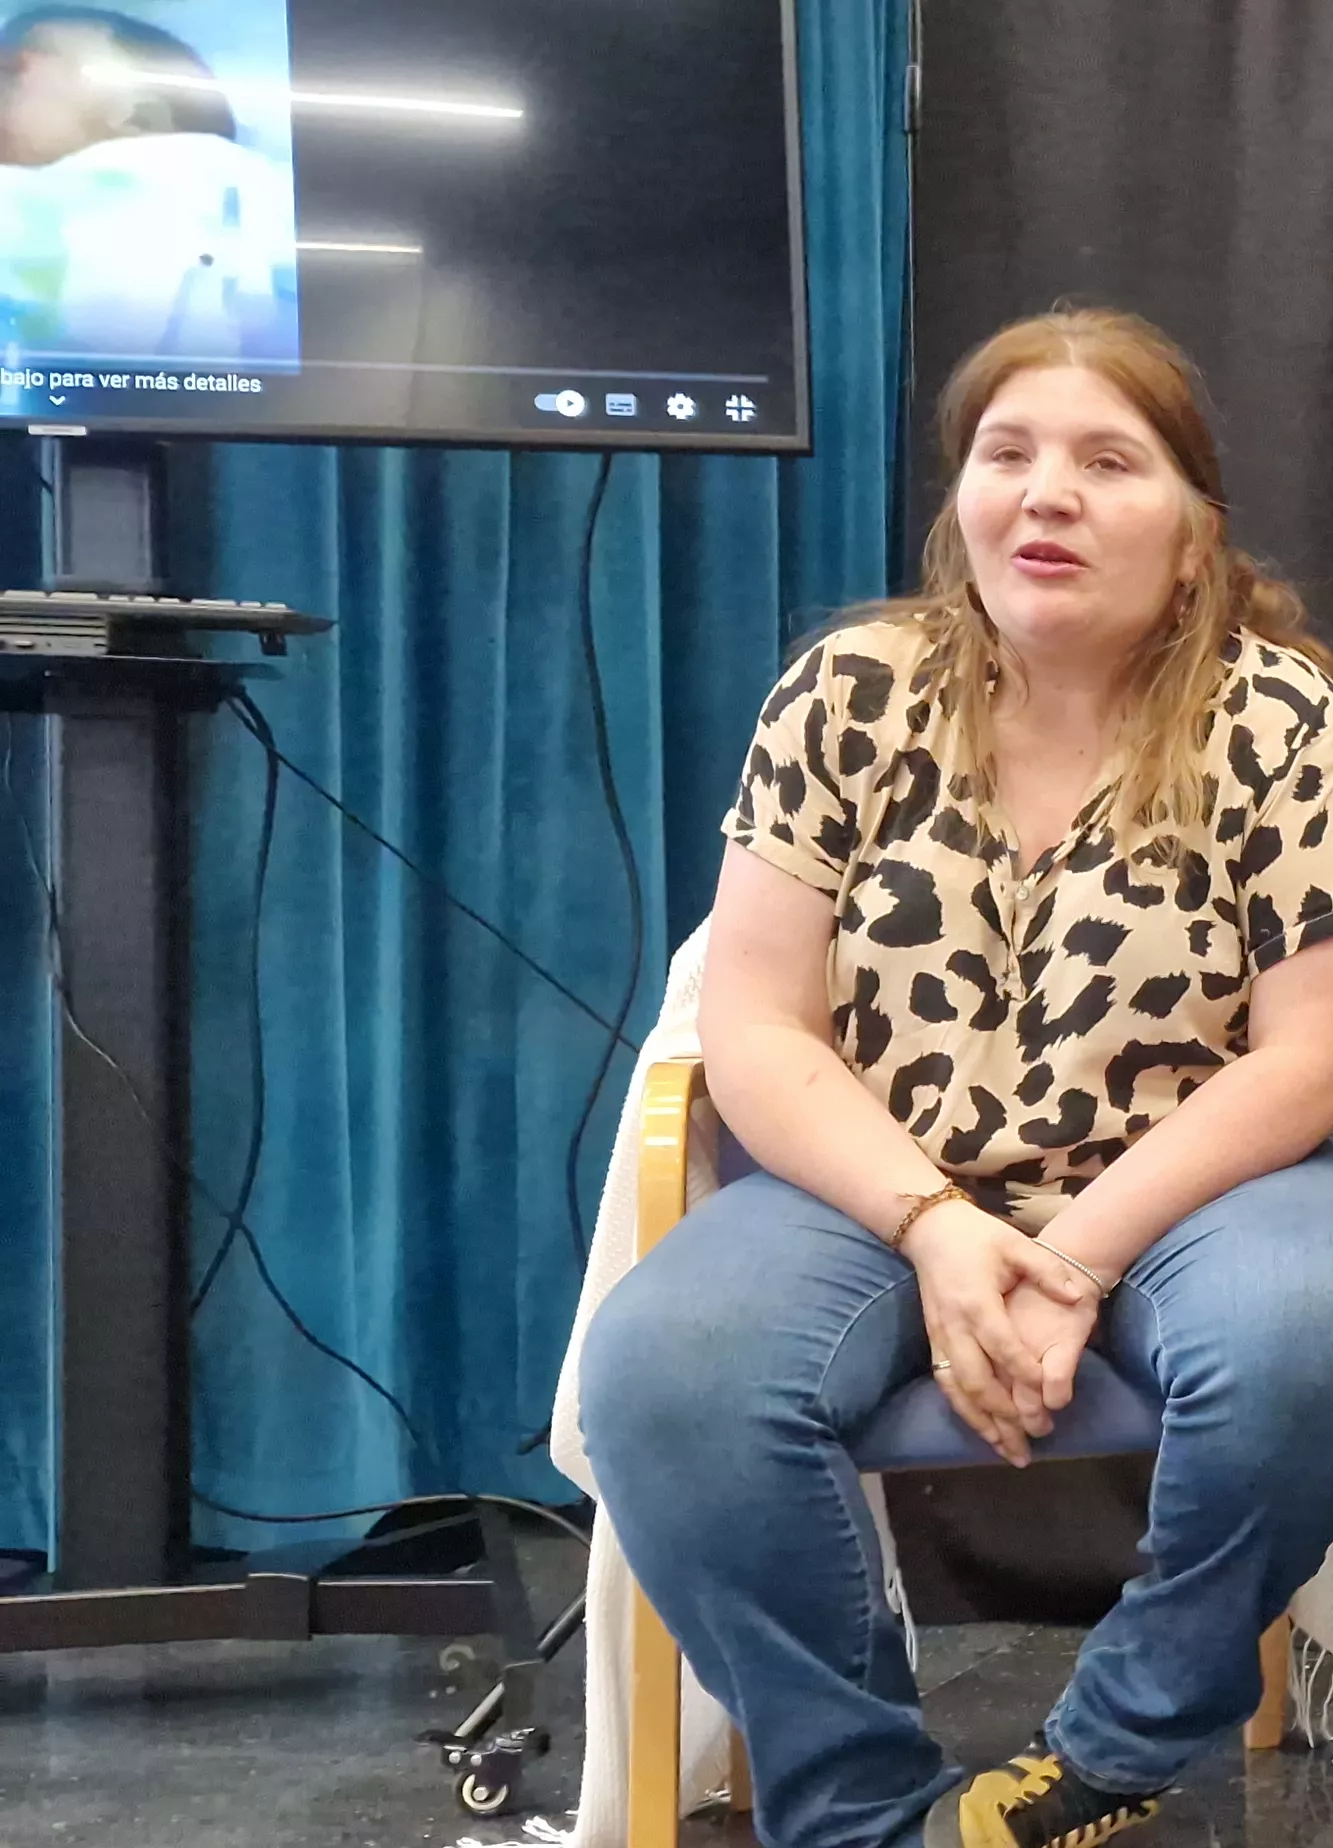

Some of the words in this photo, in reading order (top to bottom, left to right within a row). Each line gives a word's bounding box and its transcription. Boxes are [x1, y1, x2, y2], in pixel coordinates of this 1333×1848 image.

[0, 367, 44, 389] bajo
[50, 372, 94, 390] para
[99, 374, 128, 389] ver
[135, 372, 178, 391] más
[184, 373, 262, 393] detalles
